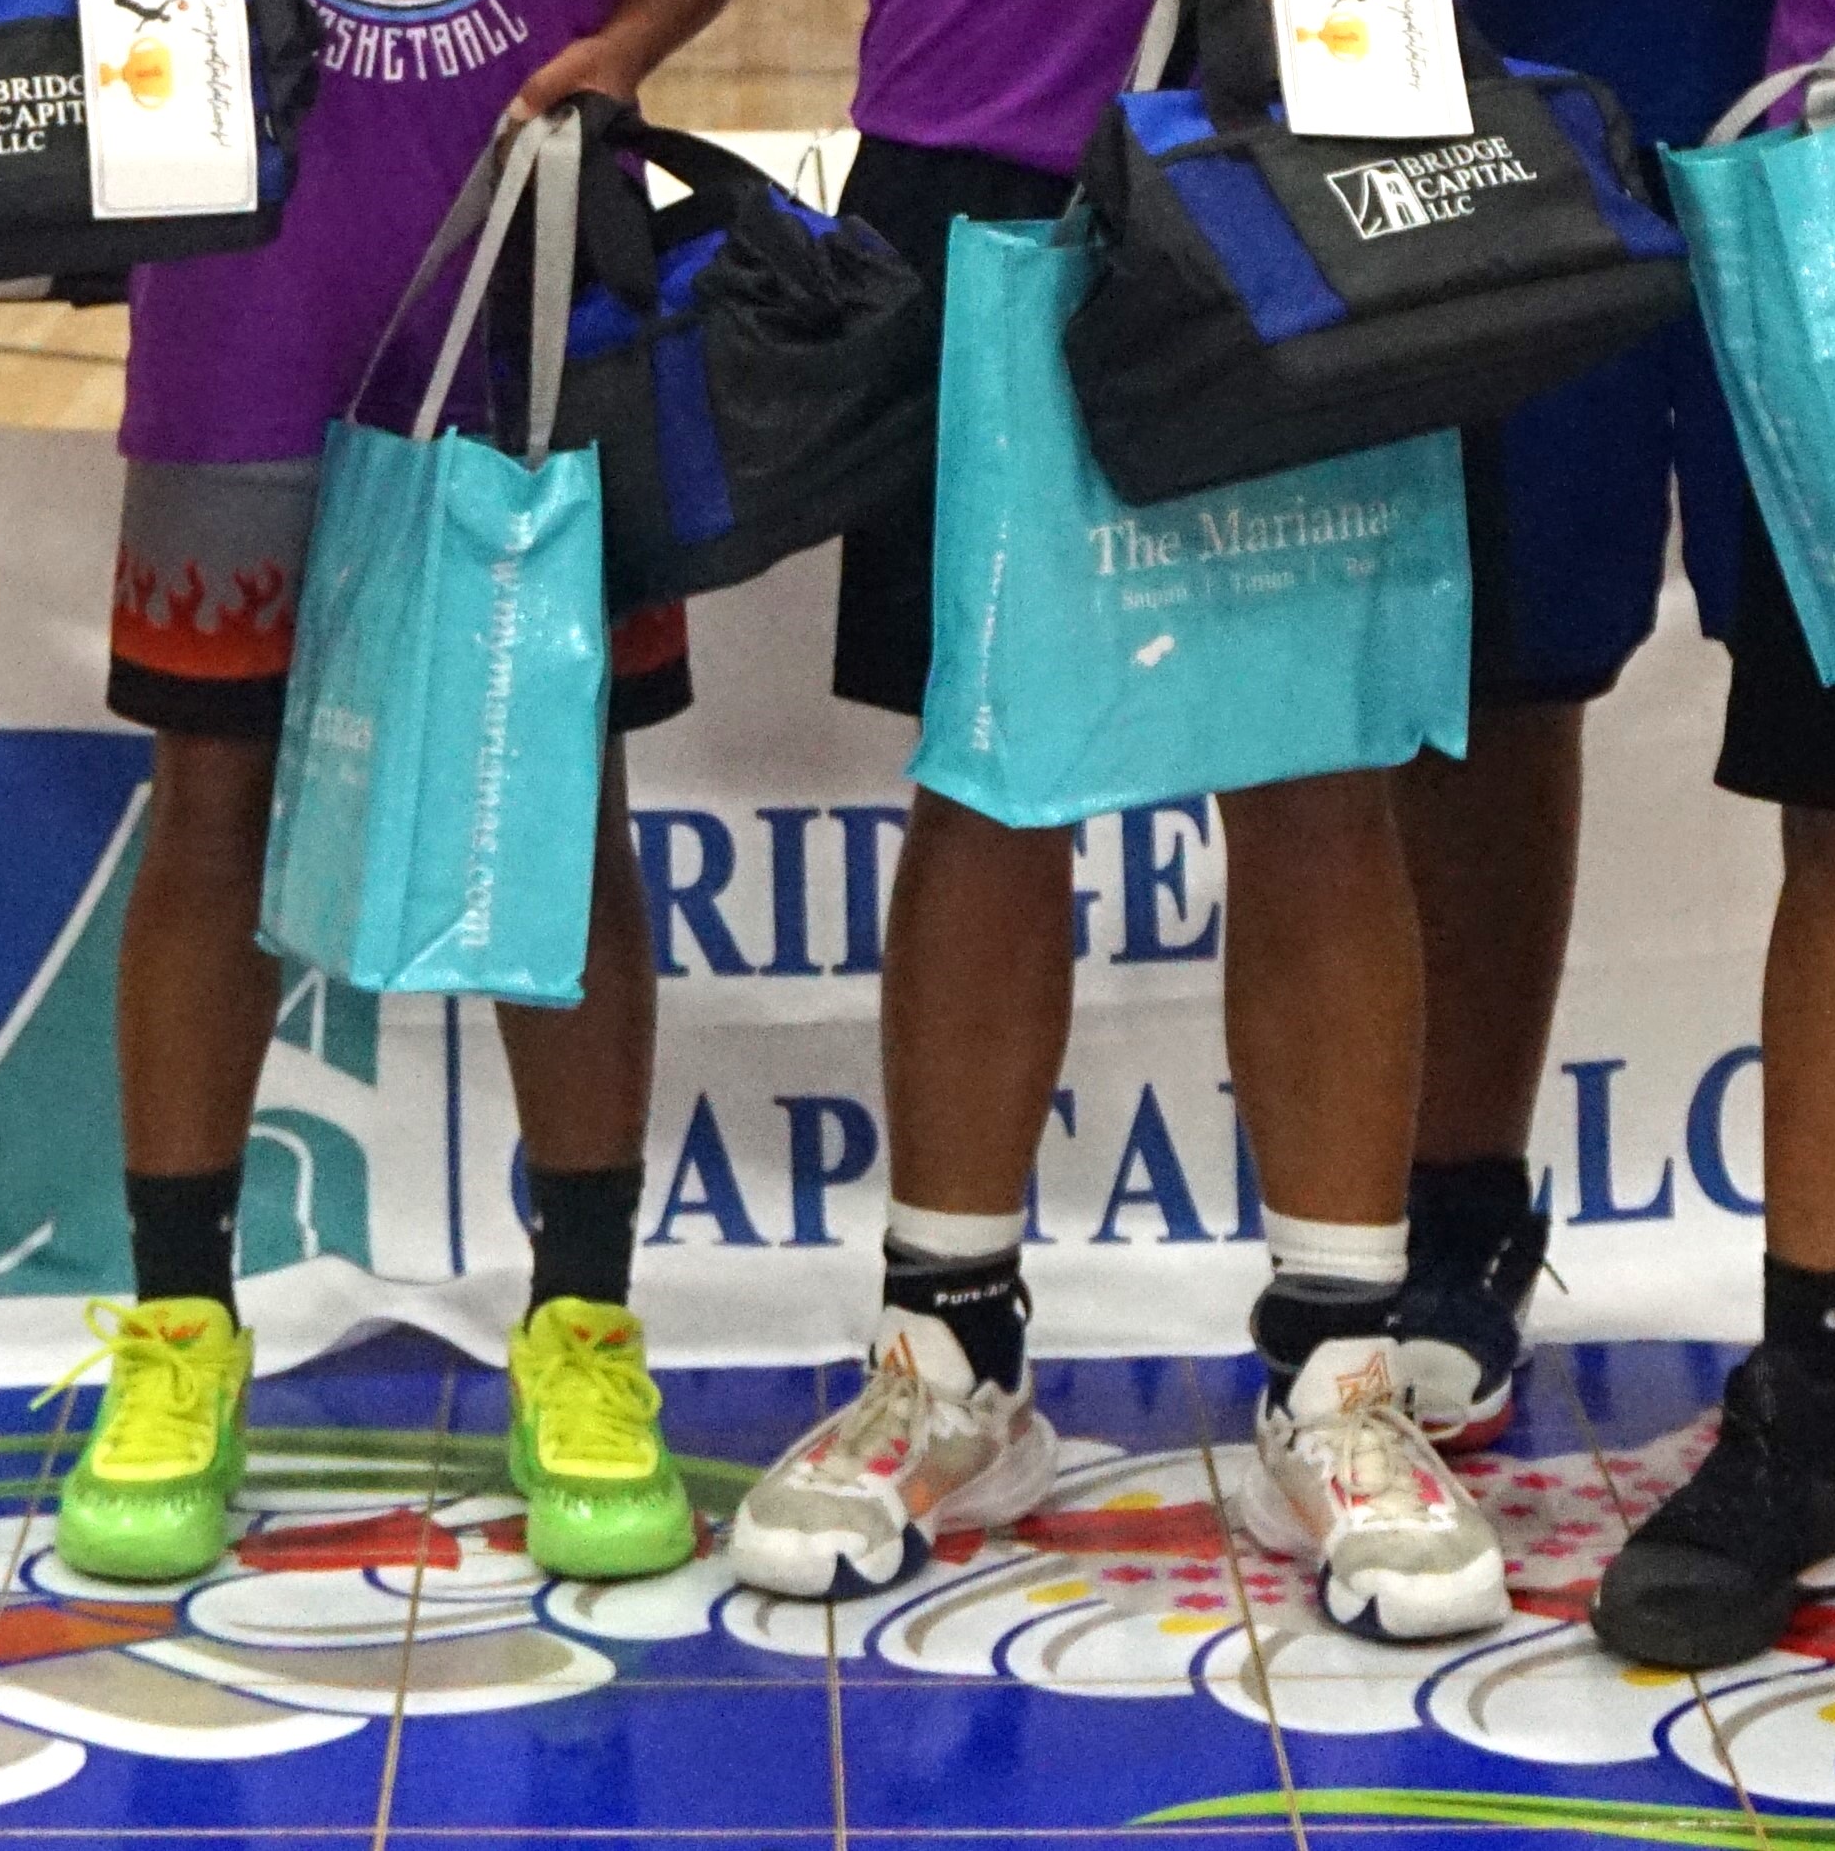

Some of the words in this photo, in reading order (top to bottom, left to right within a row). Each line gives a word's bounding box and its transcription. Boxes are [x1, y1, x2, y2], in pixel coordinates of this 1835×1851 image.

[1400, 136, 1513, 177] BRIDGE
[1415, 159, 1538, 200] CAPITAL
[1427, 194, 1476, 221] LLC
[1088, 519, 1182, 576] The
